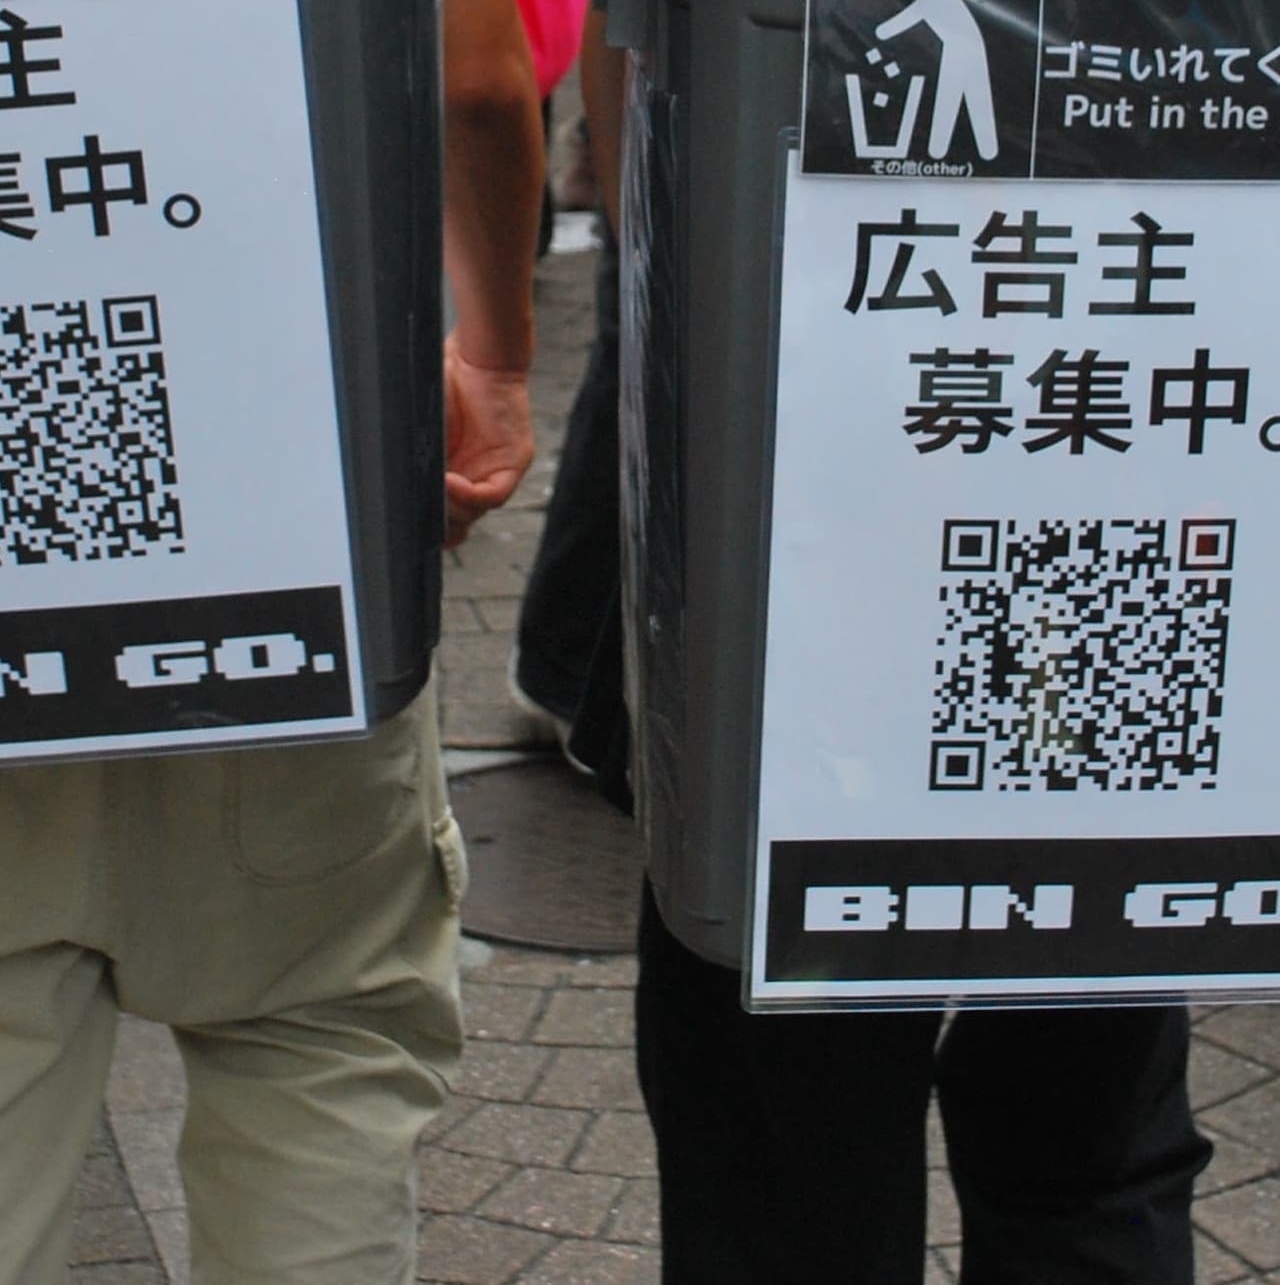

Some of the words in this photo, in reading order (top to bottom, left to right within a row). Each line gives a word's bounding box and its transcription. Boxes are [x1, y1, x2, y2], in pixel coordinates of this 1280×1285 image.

[1065, 95, 1133, 127] Put
[1151, 96, 1184, 127] in
[1201, 97, 1267, 128] the
[845, 209, 1195, 318] 広告主
[116, 634, 333, 687] GO.
[804, 885, 1073, 931] BIN
